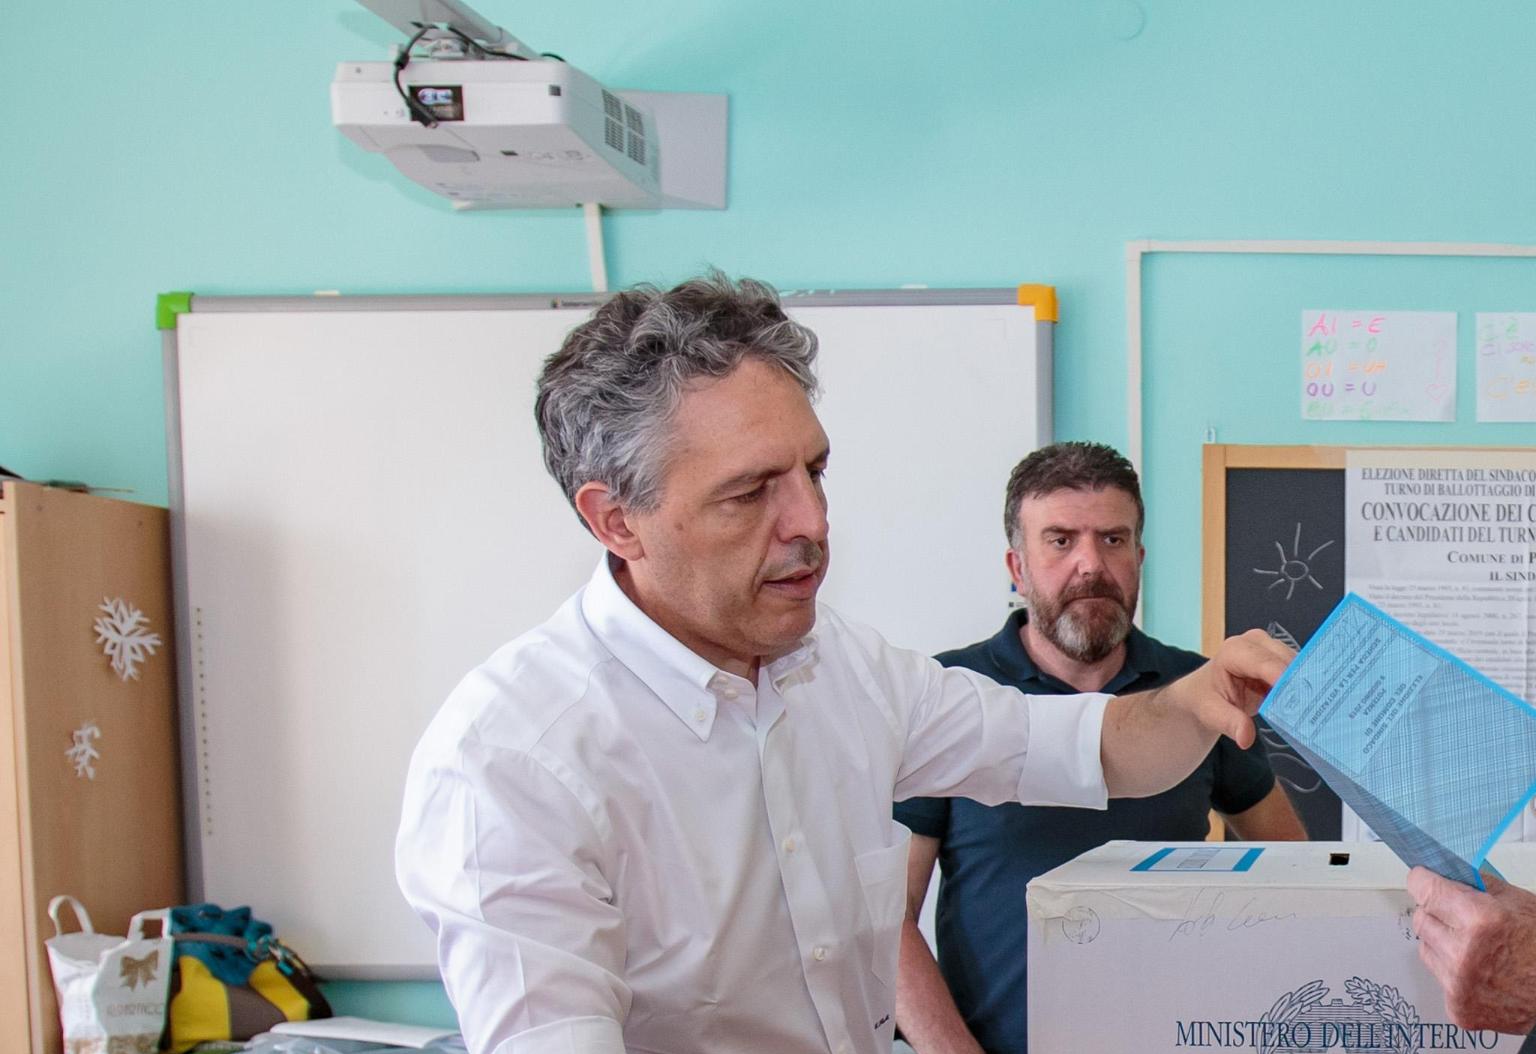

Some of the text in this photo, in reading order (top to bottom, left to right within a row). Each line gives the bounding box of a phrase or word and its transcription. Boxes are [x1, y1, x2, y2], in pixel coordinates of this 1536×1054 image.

[1361, 468, 1415, 481] ELEZIONE
[1418, 469, 1463, 482] DIRETTA
[1465, 469, 1487, 482] DEL
[1489, 470, 1536, 482] SINDACO
[1384, 482, 1421, 495] TURNO
[1424, 483, 1436, 496] DI
[1438, 483, 1522, 498] BALLOTTAGGIO
[1524, 484, 1536, 498] DI
[1361, 501, 1490, 523] CONVOCAZIONE
[1495, 503, 1522, 523] DEI
[1374, 526, 1382, 541] E
[1386, 525, 1465, 543] CANDIDATI
[1468, 526, 1495, 543] DEL
[1489, 572, 1503, 582] IL
[1361, 722, 1388, 754] SINDACO
[1175, 1021, 1499, 1051] MINISTERO DELL'INTERNO
